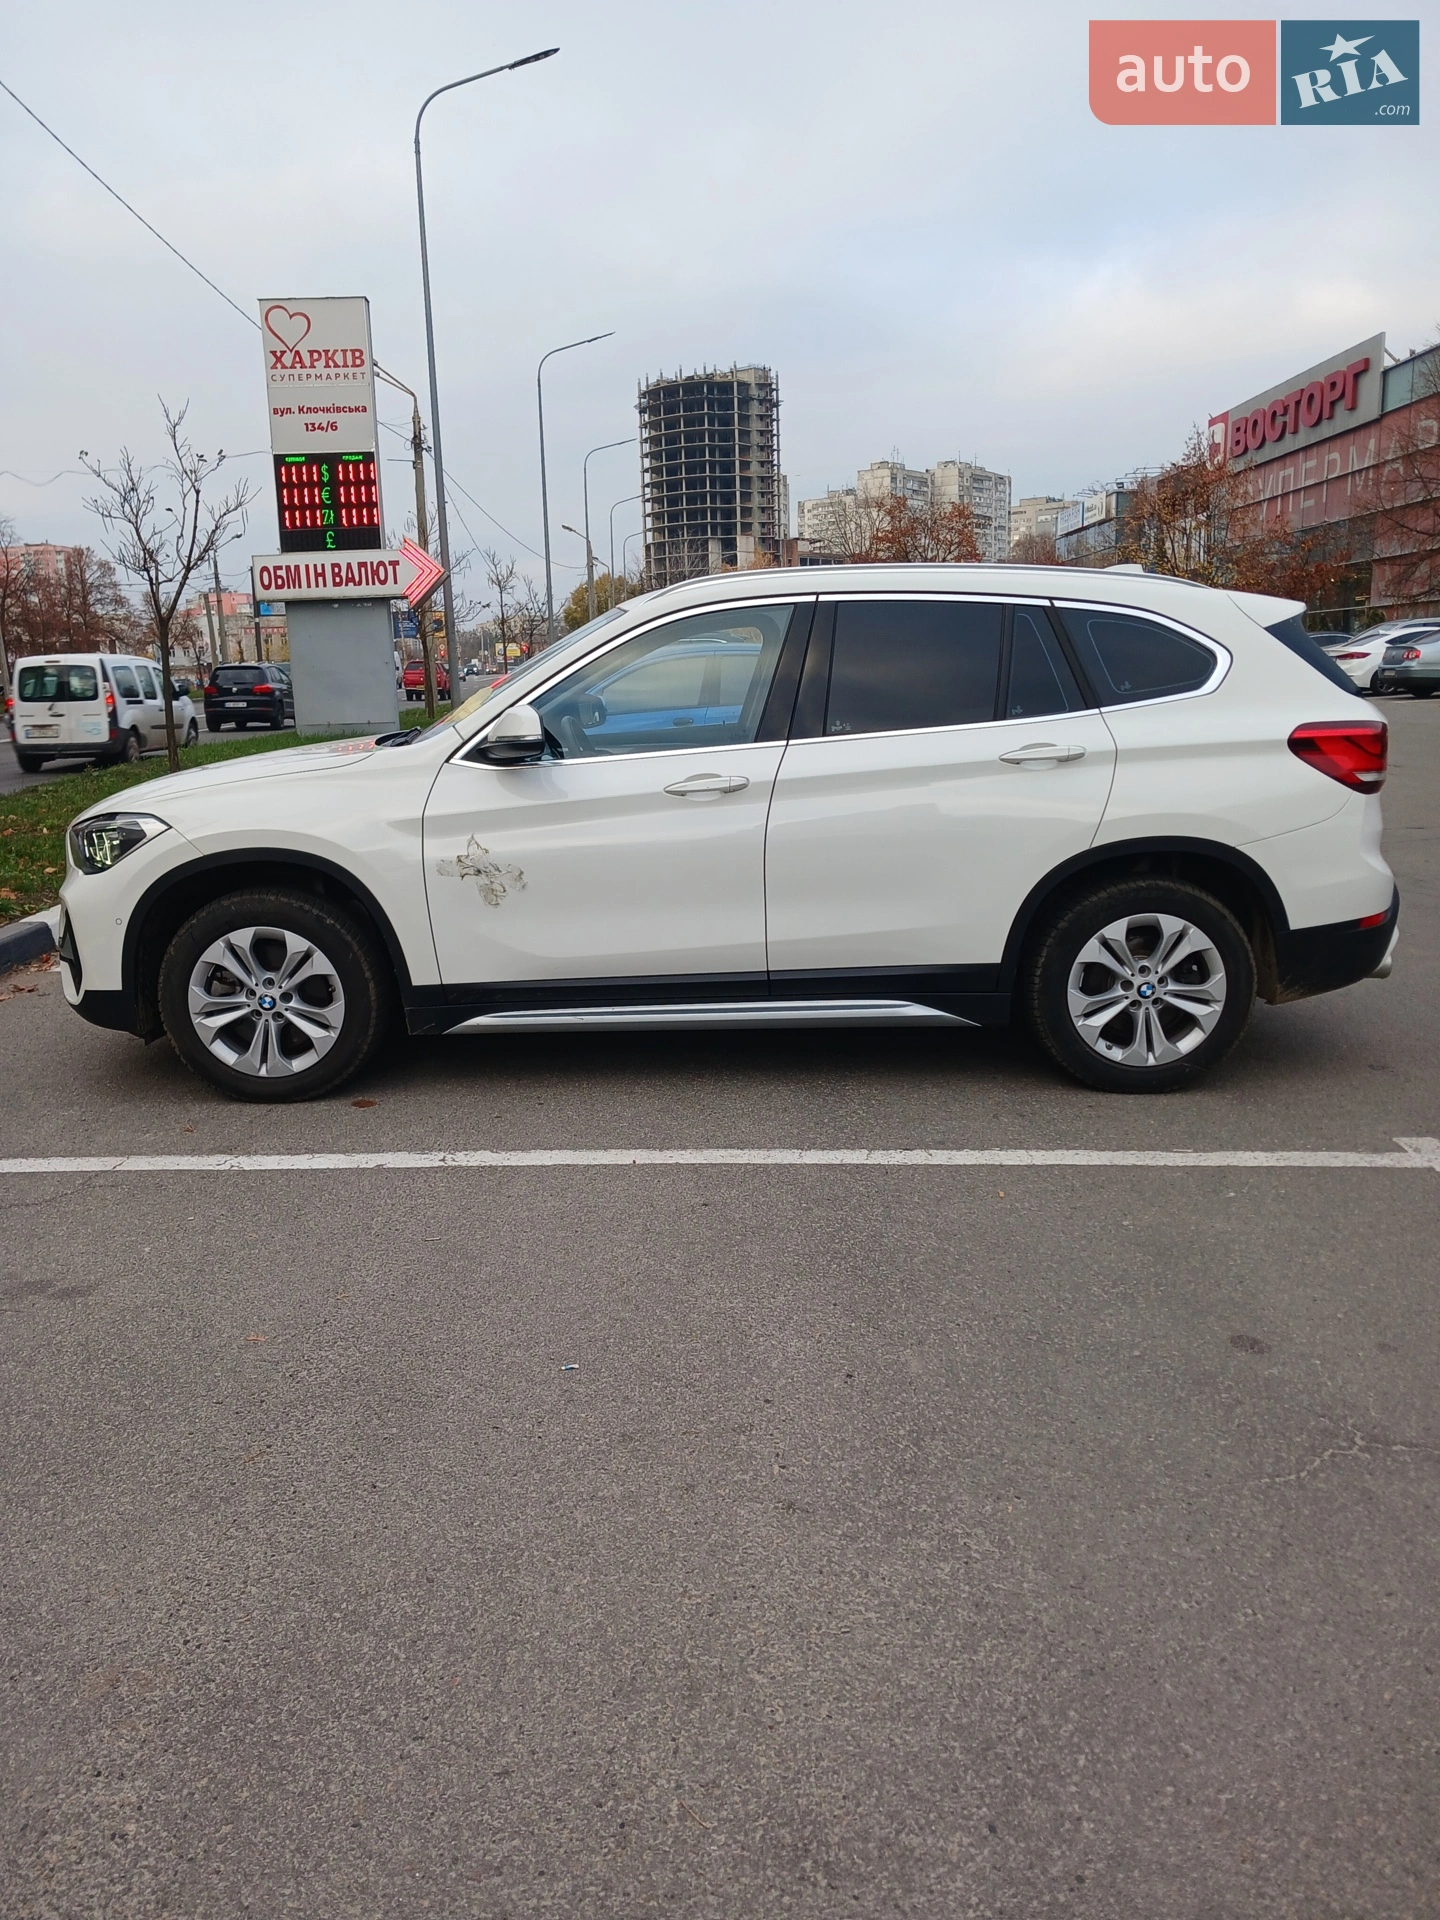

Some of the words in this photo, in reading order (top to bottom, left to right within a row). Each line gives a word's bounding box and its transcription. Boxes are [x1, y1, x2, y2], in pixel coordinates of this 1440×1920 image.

[269, 348, 366, 370] ХАРКІВ
[270, 371, 366, 382] СУПЕРМАРКЕТ
[272, 406, 296, 417] вул.
[297, 402, 368, 415] Клочківська
[1231, 357, 1370, 458] ВОСТОРГ
[303, 420, 339, 433] 134/6
[259, 563, 327, 591] ОБМІН
[330, 559, 400, 588] ВАЛЮТ
